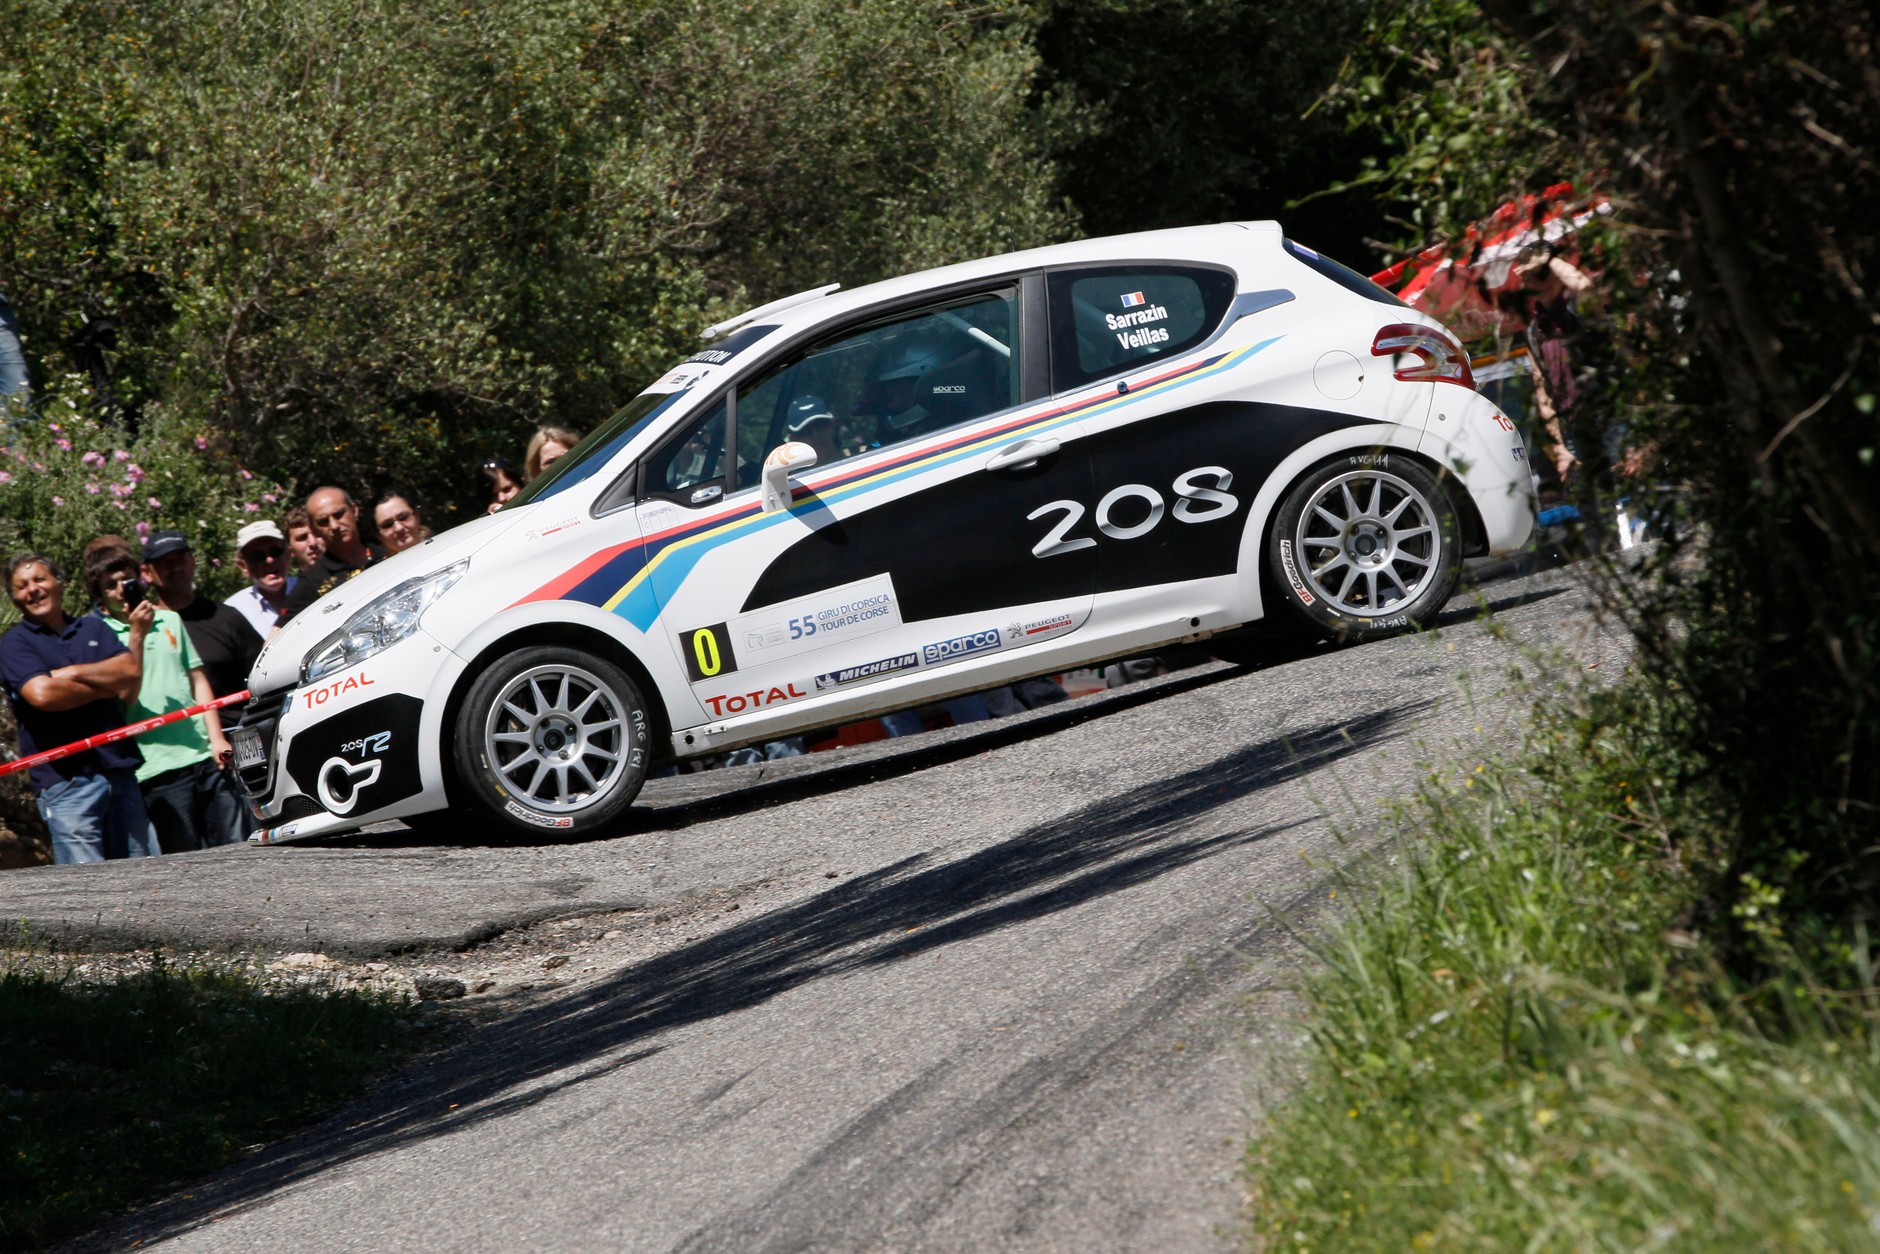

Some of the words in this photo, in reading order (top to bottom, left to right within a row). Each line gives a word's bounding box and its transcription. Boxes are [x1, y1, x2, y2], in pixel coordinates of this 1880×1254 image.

[1105, 304, 1168, 330] Sarrazin
[1116, 327, 1169, 350] Veillas
[932, 385, 966, 394] sparco
[1026, 466, 1239, 559] 208
[1282, 541, 1313, 603] BFGoodrich
[817, 608, 840, 621] GIRU
[840, 605, 851, 615] DI
[851, 594, 890, 611] CORSICA
[820, 618, 847, 632] TOUR
[847, 614, 860, 625] DE
[860, 605, 890, 621] CORSE
[789, 615, 817, 640] 55
[1025, 614, 1071, 630] PEUGEOT
[693, 628, 721, 676] 0
[925, 631, 999, 661] sparco
[838, 653, 917, 682] MICHELIN
[303, 672, 375, 709] TOTAL
[705, 683, 807, 716] TOTAL
[508, 802, 571, 828] BFGoodrich
